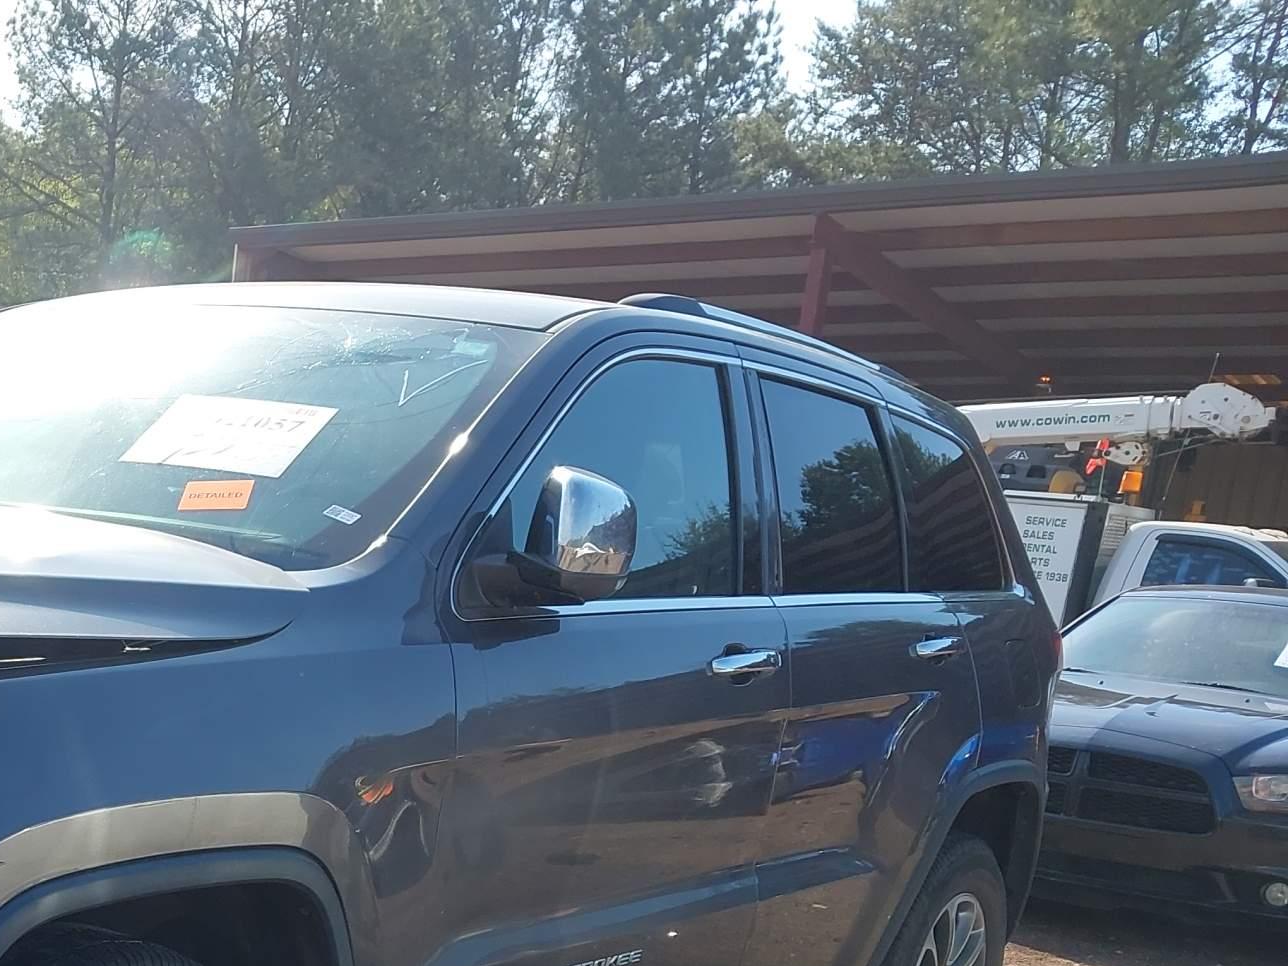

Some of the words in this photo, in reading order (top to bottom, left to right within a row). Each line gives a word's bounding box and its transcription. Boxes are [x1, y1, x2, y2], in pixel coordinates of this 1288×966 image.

[995, 413, 1111, 428] www.cowin.com
[188, 491, 244, 499] DETAILED
[1024, 515, 1067, 528] SERVICE
[1022, 529, 1055, 540] SALES
[1045, 572, 1068, 582] 1938
